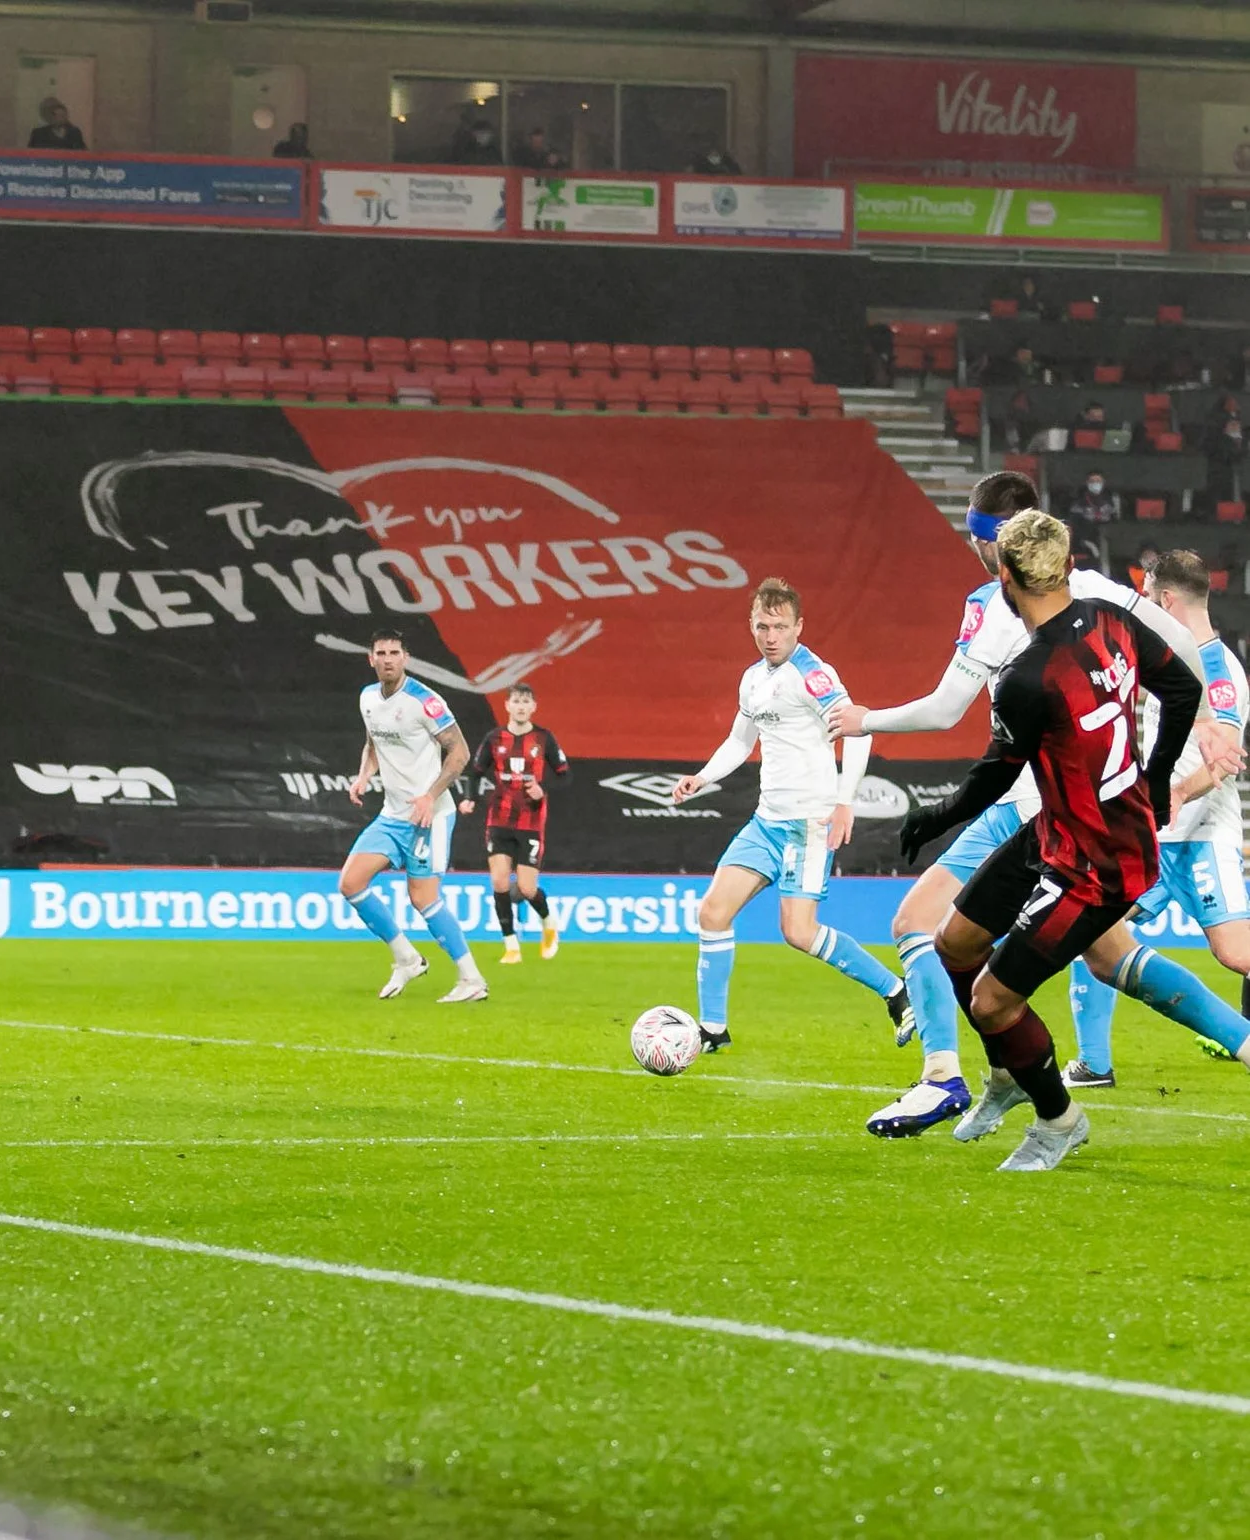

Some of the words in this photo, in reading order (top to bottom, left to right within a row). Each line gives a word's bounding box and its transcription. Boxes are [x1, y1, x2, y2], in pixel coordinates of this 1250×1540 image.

[936, 71, 1078, 158] Vitality
[67, 164, 91, 179] the
[94, 165, 126, 183] App
[7, 183, 67, 199] Receive
[70, 185, 155, 202] Discounted
[159, 188, 201, 204] Fares
[206, 499, 417, 550] Thank
[426, 501, 523, 542] you
[63, 566, 259, 635] KEY
[253, 530, 750, 616] WORKERS
[955, 661, 982, 680] SPECT
[528, 838, 540, 857] 7
[1191, 860, 1215, 895] 5
